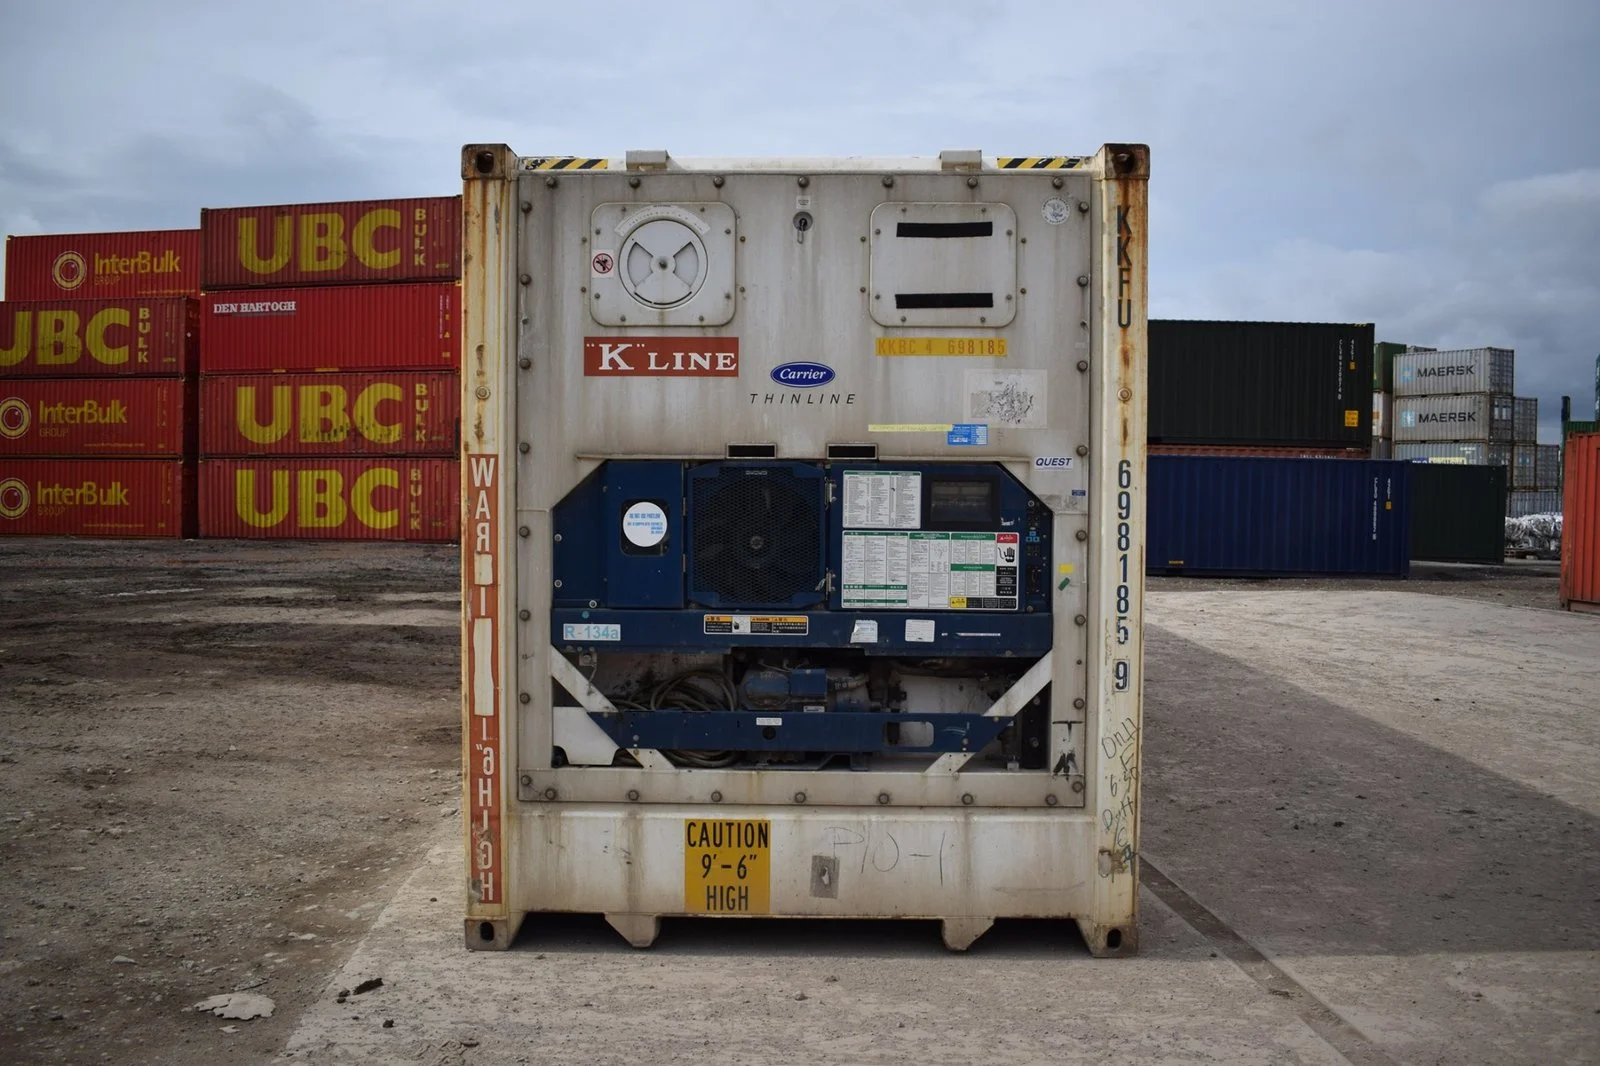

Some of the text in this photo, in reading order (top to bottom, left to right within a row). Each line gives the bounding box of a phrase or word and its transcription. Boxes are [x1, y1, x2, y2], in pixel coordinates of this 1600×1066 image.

[238, 208, 401, 274] UBC
[414, 208, 427, 266] BULK
[94, 249, 181, 274] InterBulk
[1117, 205, 1132, 329] KKFU
[213, 301, 296, 313] DEN HARTOGH
[138, 308, 150, 363] BULK
[878, 339, 1006, 354] KKBC 4 698185
[648, 352, 737, 370] LINE
[780, 368, 826, 380] Carrier
[1417, 365, 1475, 377] MAERSK
[39, 399, 127, 424] InterBulk
[750, 393, 856, 404] THINLINE
[236, 382, 403, 444] UBC
[415, 383, 428, 442] BULK
[1419, 411, 1476, 423] MAERSK
[1036, 457, 1072, 467] QUEST
[37, 480, 128, 506] InterBulk
[236, 467, 398, 529] UBC
[410, 468, 422, 530] BULK
[1114, 459, 1131, 690] 698185 9
[687, 822, 769, 849] CAUTION
[706, 885, 749, 911] HIGH
